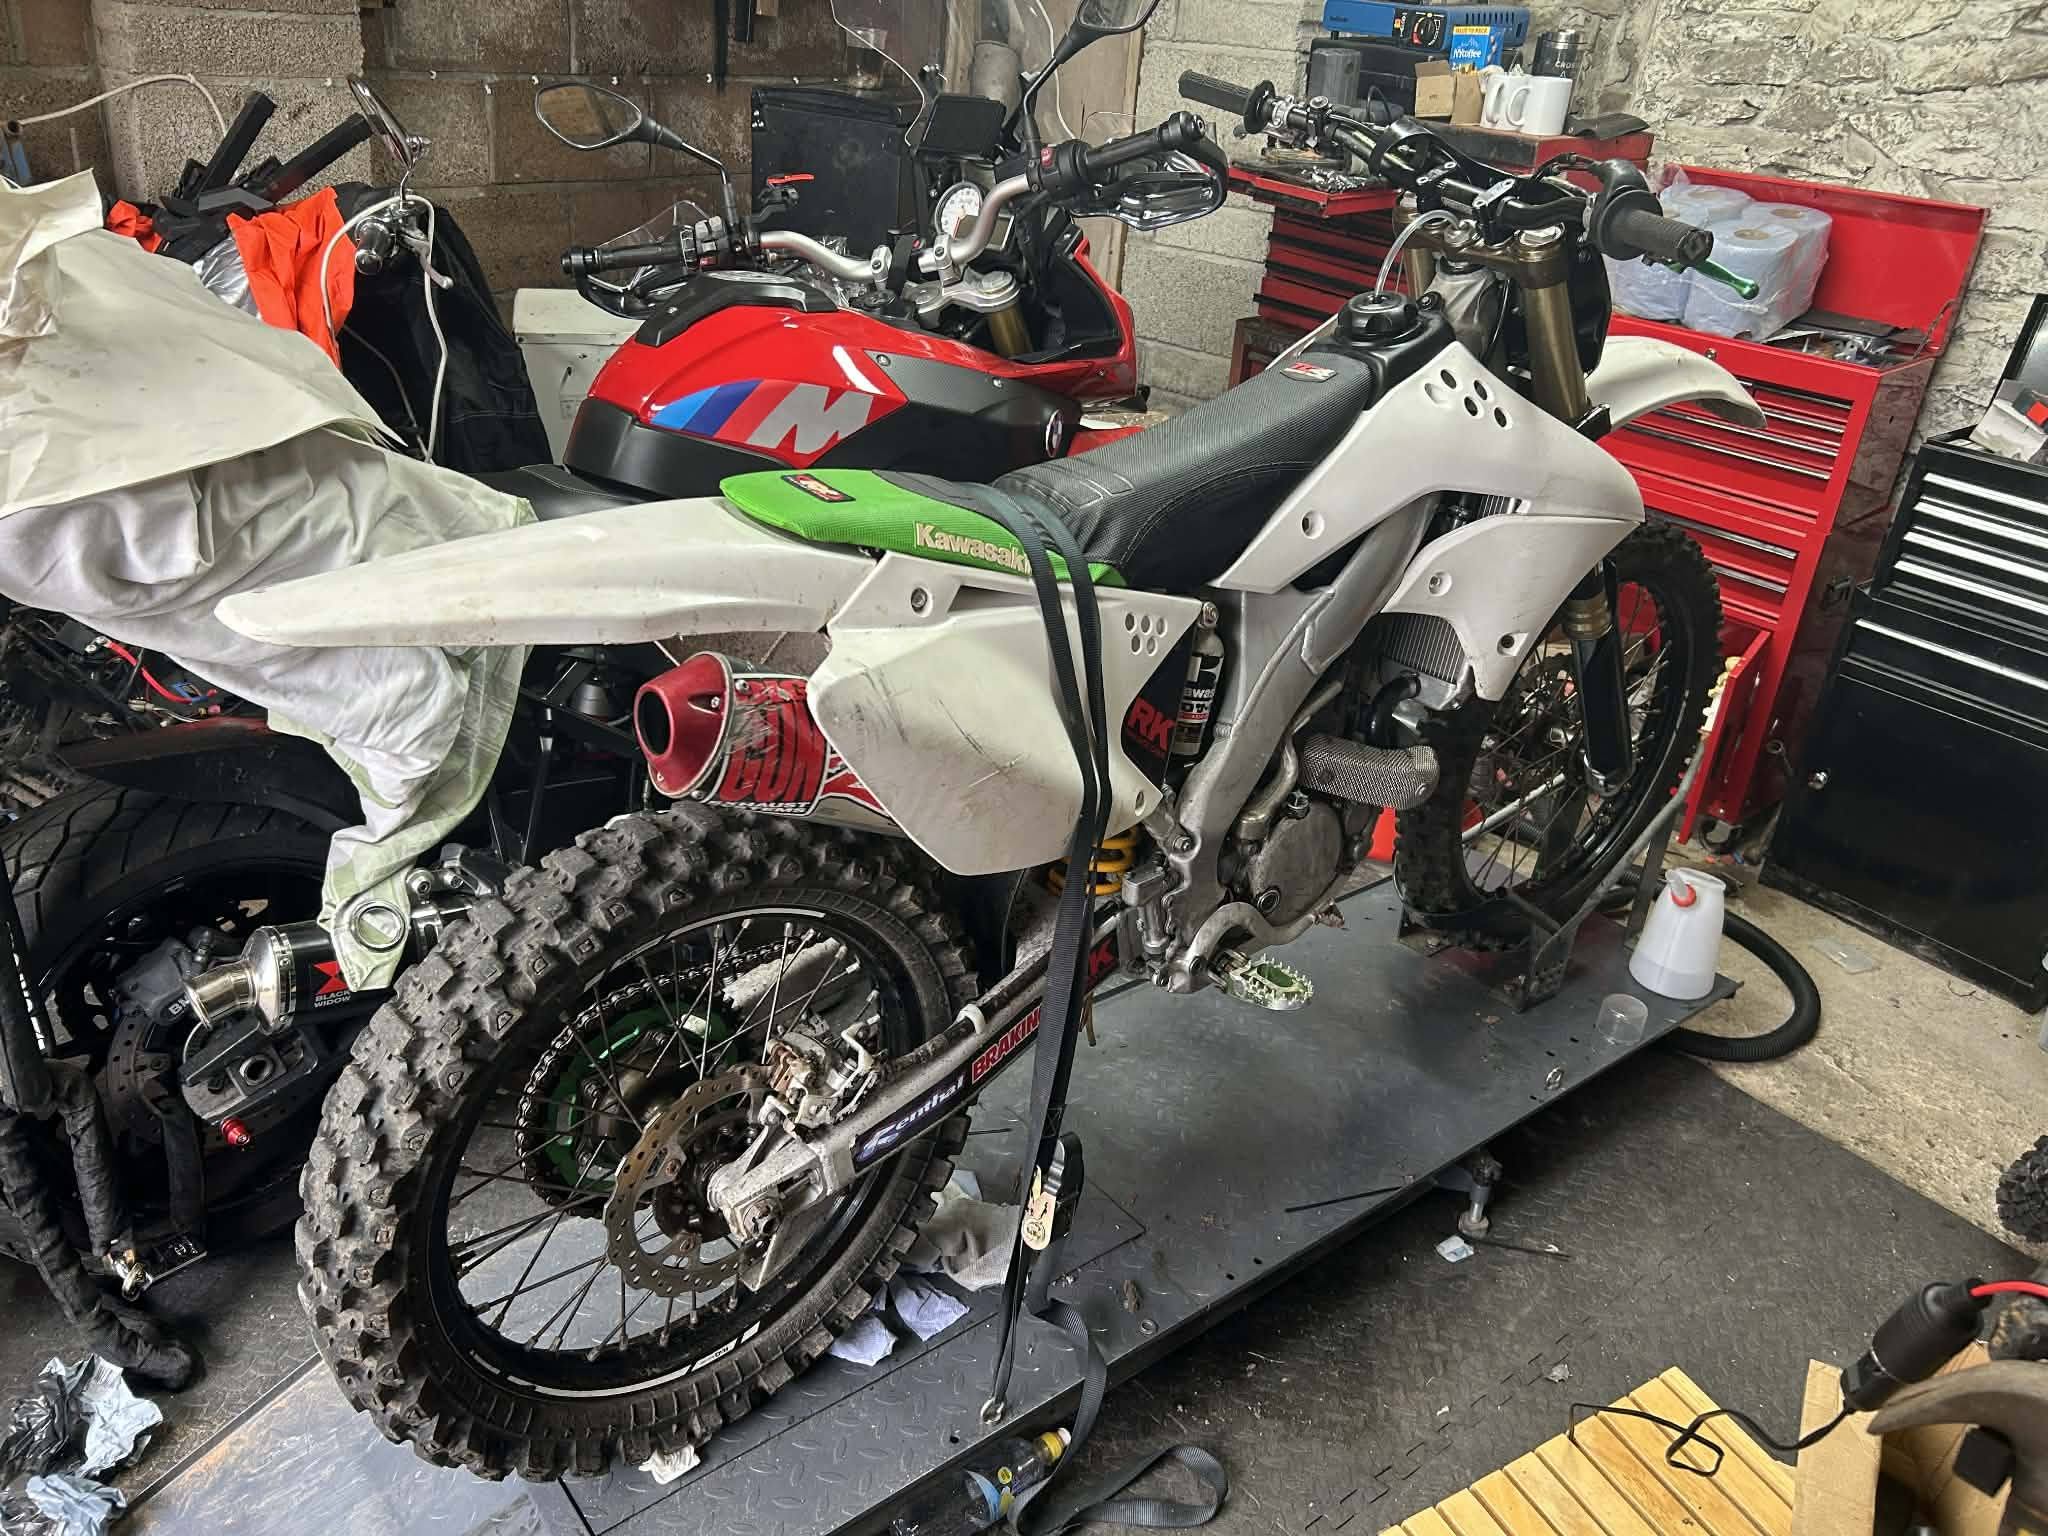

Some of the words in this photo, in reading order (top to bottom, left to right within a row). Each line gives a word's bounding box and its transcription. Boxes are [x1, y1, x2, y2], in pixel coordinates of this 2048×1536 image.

[744, 382, 874, 455] M
[1127, 698, 1175, 753] RK
[314, 995, 351, 1008] WIDOW
[315, 990, 351, 1002] BLACK
[971, 1007, 1042, 1085] BRAKIN
